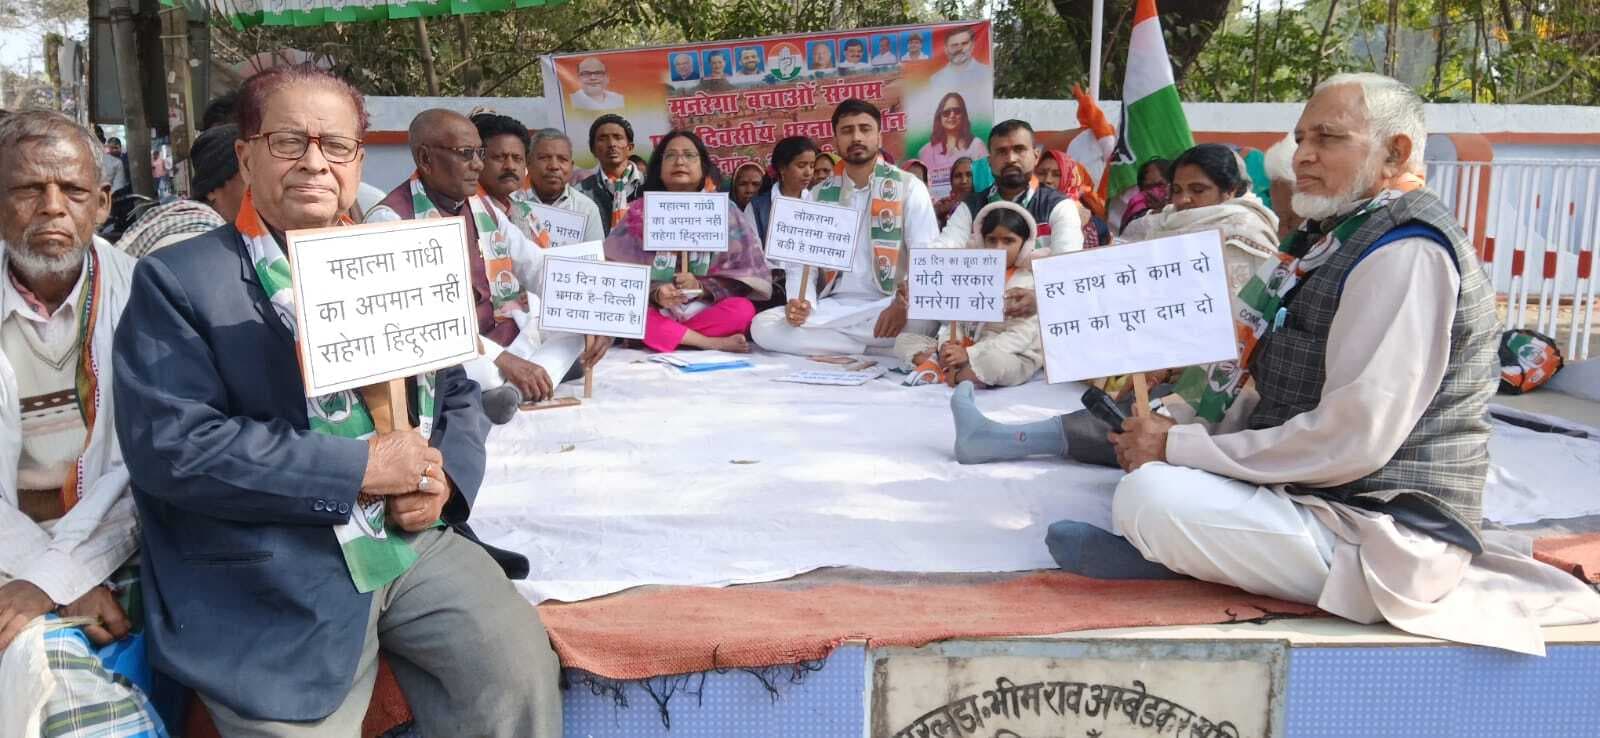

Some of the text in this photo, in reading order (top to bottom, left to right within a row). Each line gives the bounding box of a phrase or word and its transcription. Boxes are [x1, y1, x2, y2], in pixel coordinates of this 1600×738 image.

[658, 199, 715, 212] महात्मा गांधी
[652, 215, 665, 226] का
[668, 215, 702, 226] अपमान
[650, 228, 676, 241] सहेगा
[776, 221, 851, 245] विधानसभा सबसे
[327, 238, 444, 281] महात्मा गांधी
[913, 257, 927, 266] 125
[930, 254, 945, 266] दिन
[949, 256, 959, 266] का
[982, 254, 998, 266] शोर
[551, 271, 645, 291] 125 दिन का दावा
[915, 269, 995, 287] मोदी सरकार
[1044, 251, 1211, 299] हर हाथ को काम दो
[316, 273, 462, 323] का अपमान नहीं
[913, 290, 997, 311] मनरेगा चोर
[546, 306, 561, 318] का
[564, 307, 590, 321] दावा
[594, 310, 625, 322] नाटक
[1047, 293, 1214, 337] काम का पूरा दाम दो
[317, 315, 468, 364] सहेगा हिंदूस्तान।
